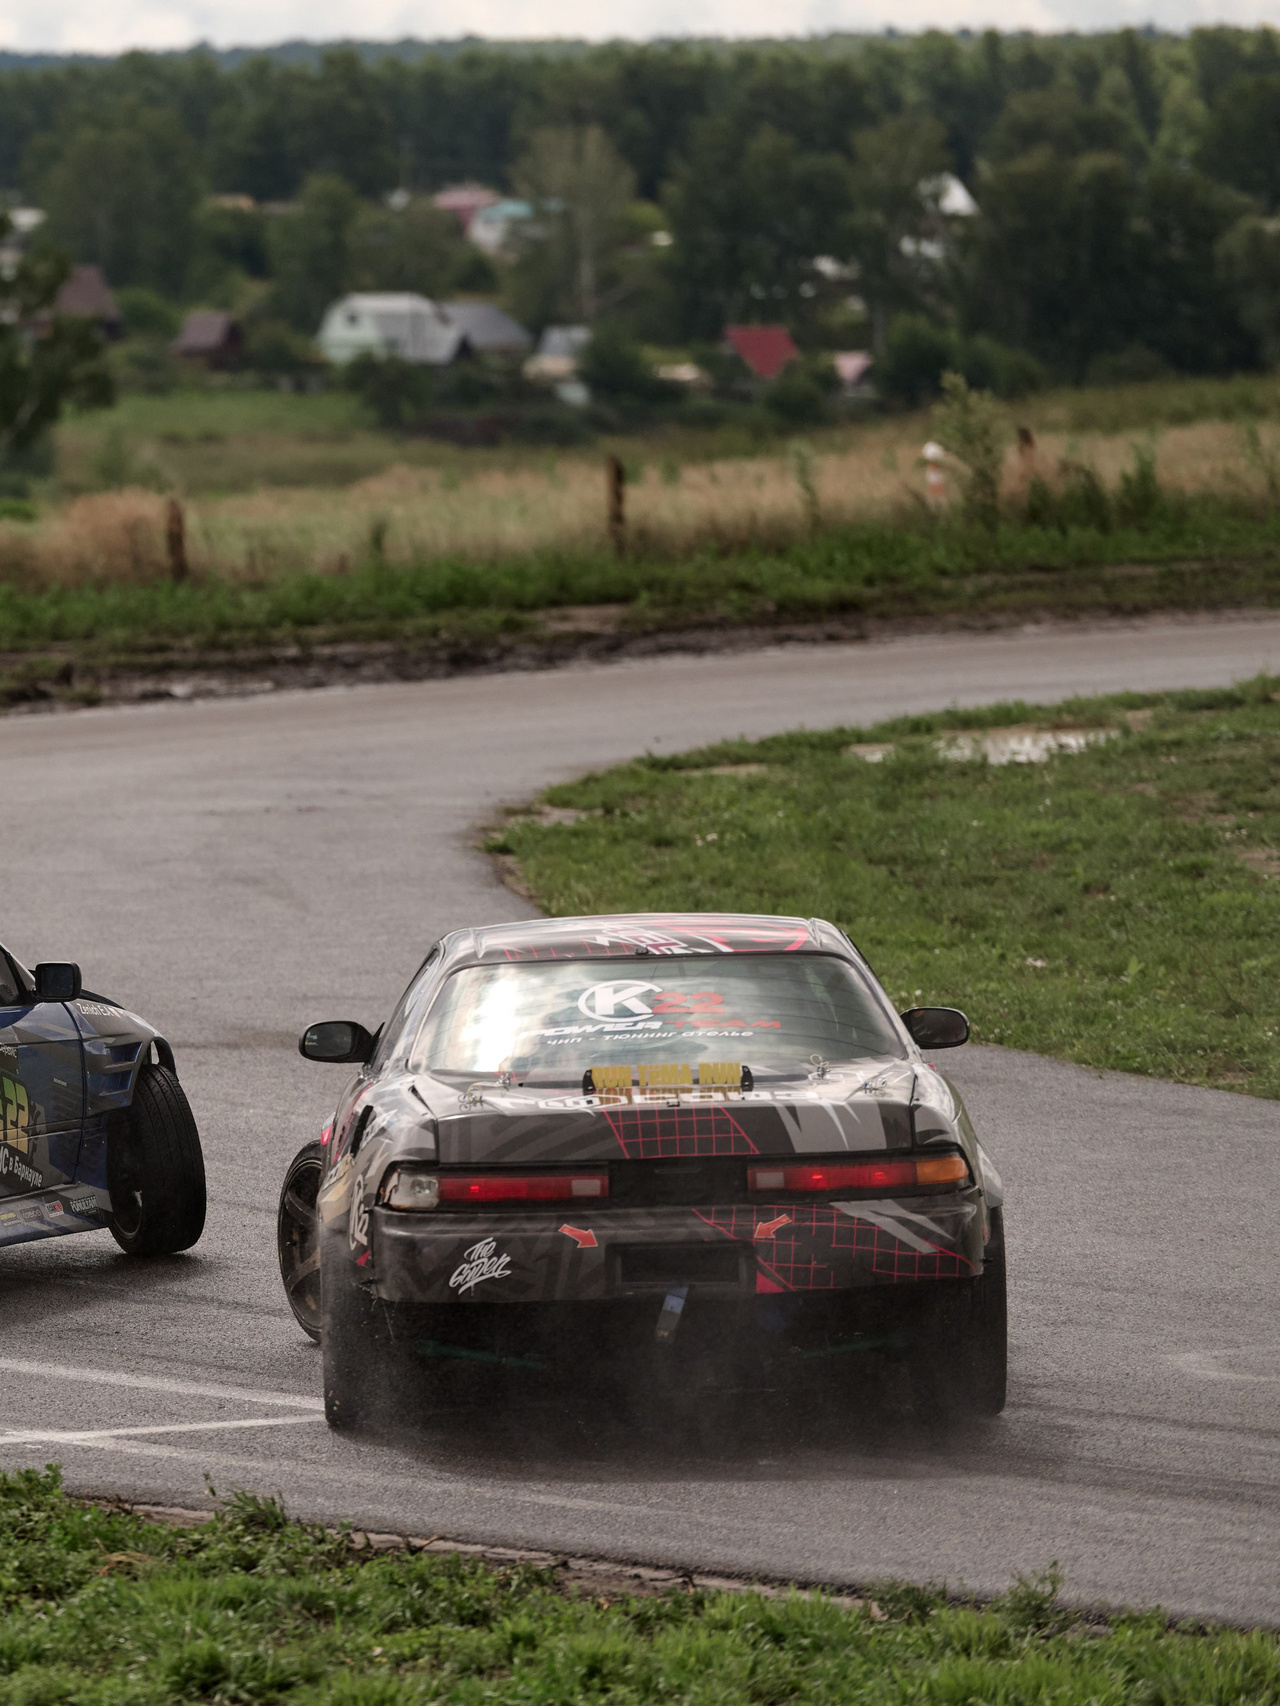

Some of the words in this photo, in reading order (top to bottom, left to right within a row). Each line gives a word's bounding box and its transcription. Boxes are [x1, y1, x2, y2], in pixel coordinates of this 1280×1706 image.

[665, 1020, 781, 1029] TEAM
[681, 1030, 755, 1038] ателье
[592, 1065, 632, 1088] RUN
[699, 1062, 741, 1085] RUN
[14, 1156, 43, 1187] Барнауле
